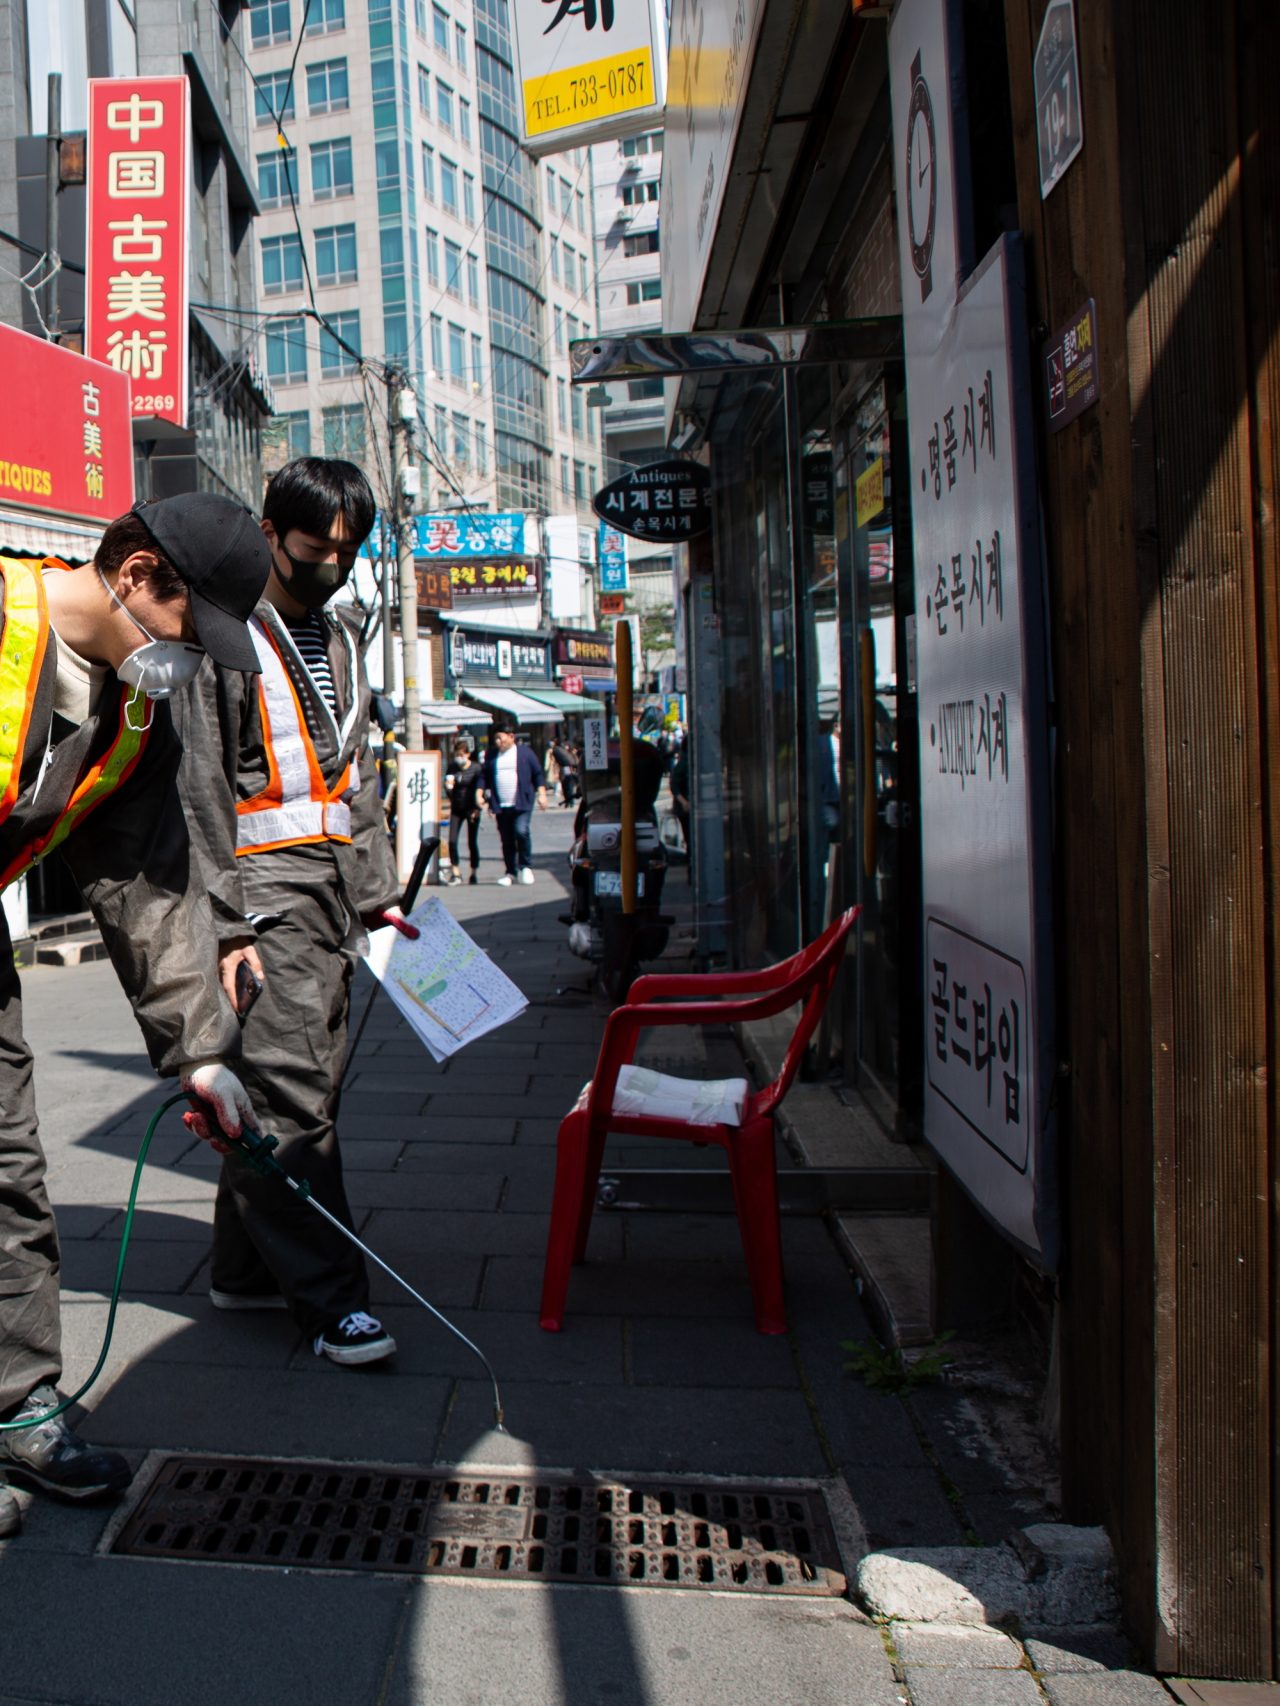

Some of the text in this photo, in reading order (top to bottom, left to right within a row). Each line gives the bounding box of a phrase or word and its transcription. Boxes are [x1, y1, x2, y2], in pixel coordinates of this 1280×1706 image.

[629, 469, 692, 484] Antiques
[933, 530, 1004, 636] 손목시계
[930, 958, 1020, 1125] 골드타임
